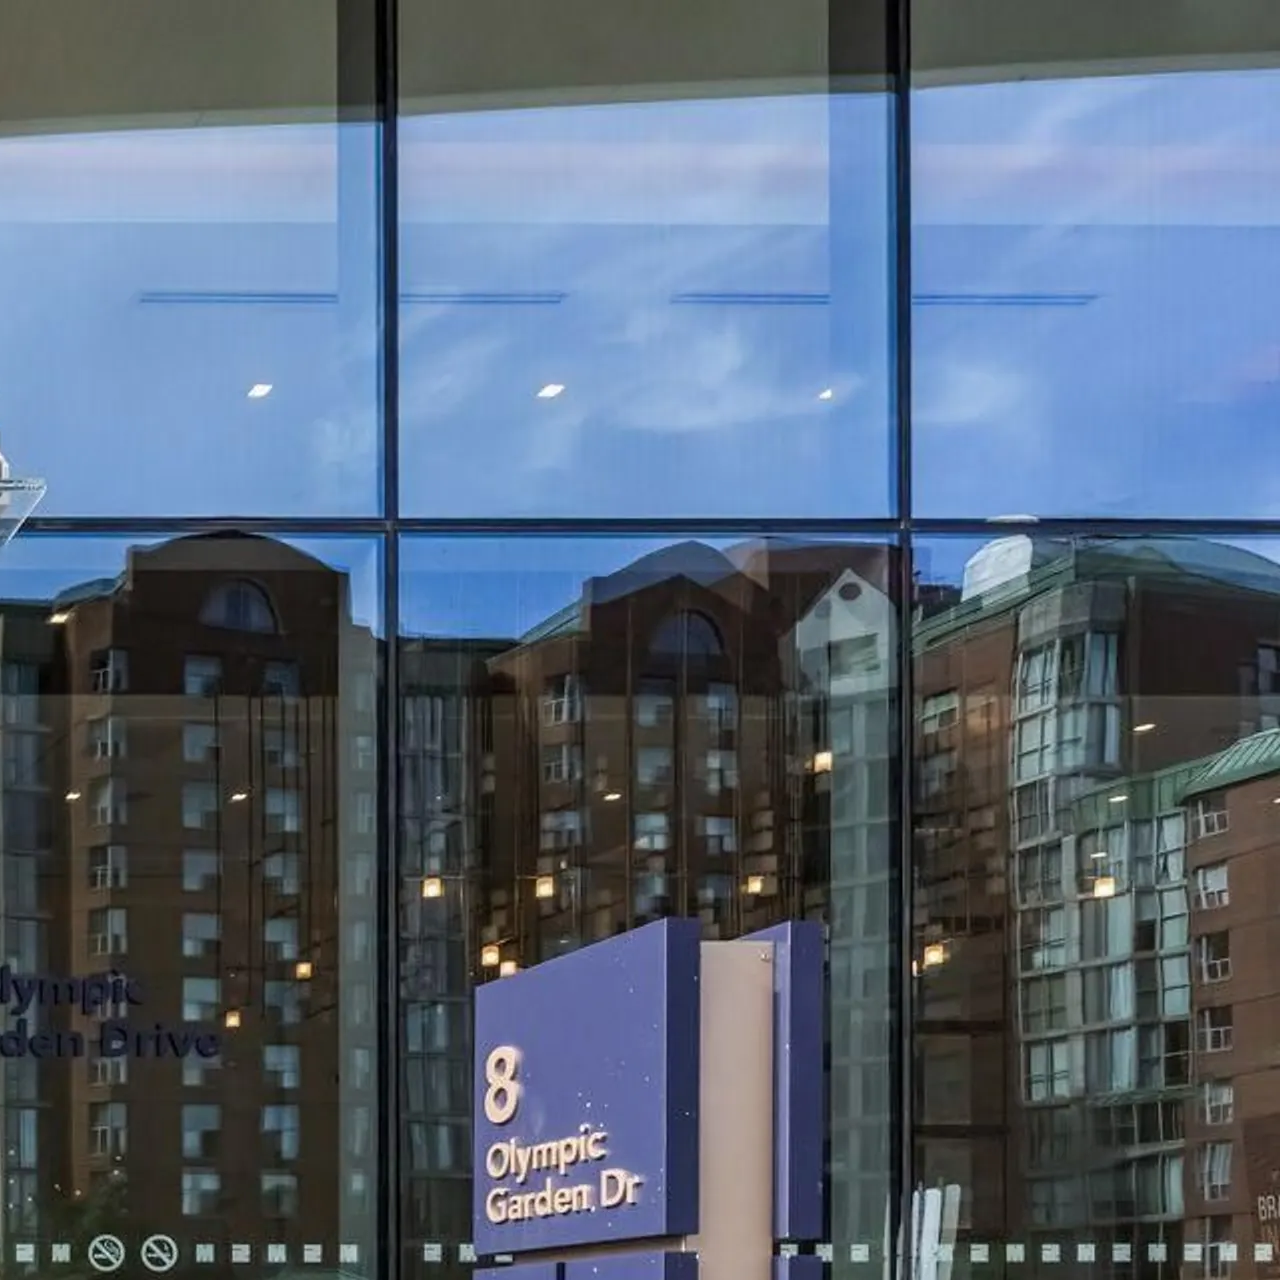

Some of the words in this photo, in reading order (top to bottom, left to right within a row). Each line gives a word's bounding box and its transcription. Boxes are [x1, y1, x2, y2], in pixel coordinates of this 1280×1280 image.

[99, 1021, 223, 1058] Drive
[484, 1045, 522, 1125] 8
[486, 1122, 608, 1185] Olympic
[486, 1177, 591, 1225] Garden
[599, 1168, 644, 1208] Dr
